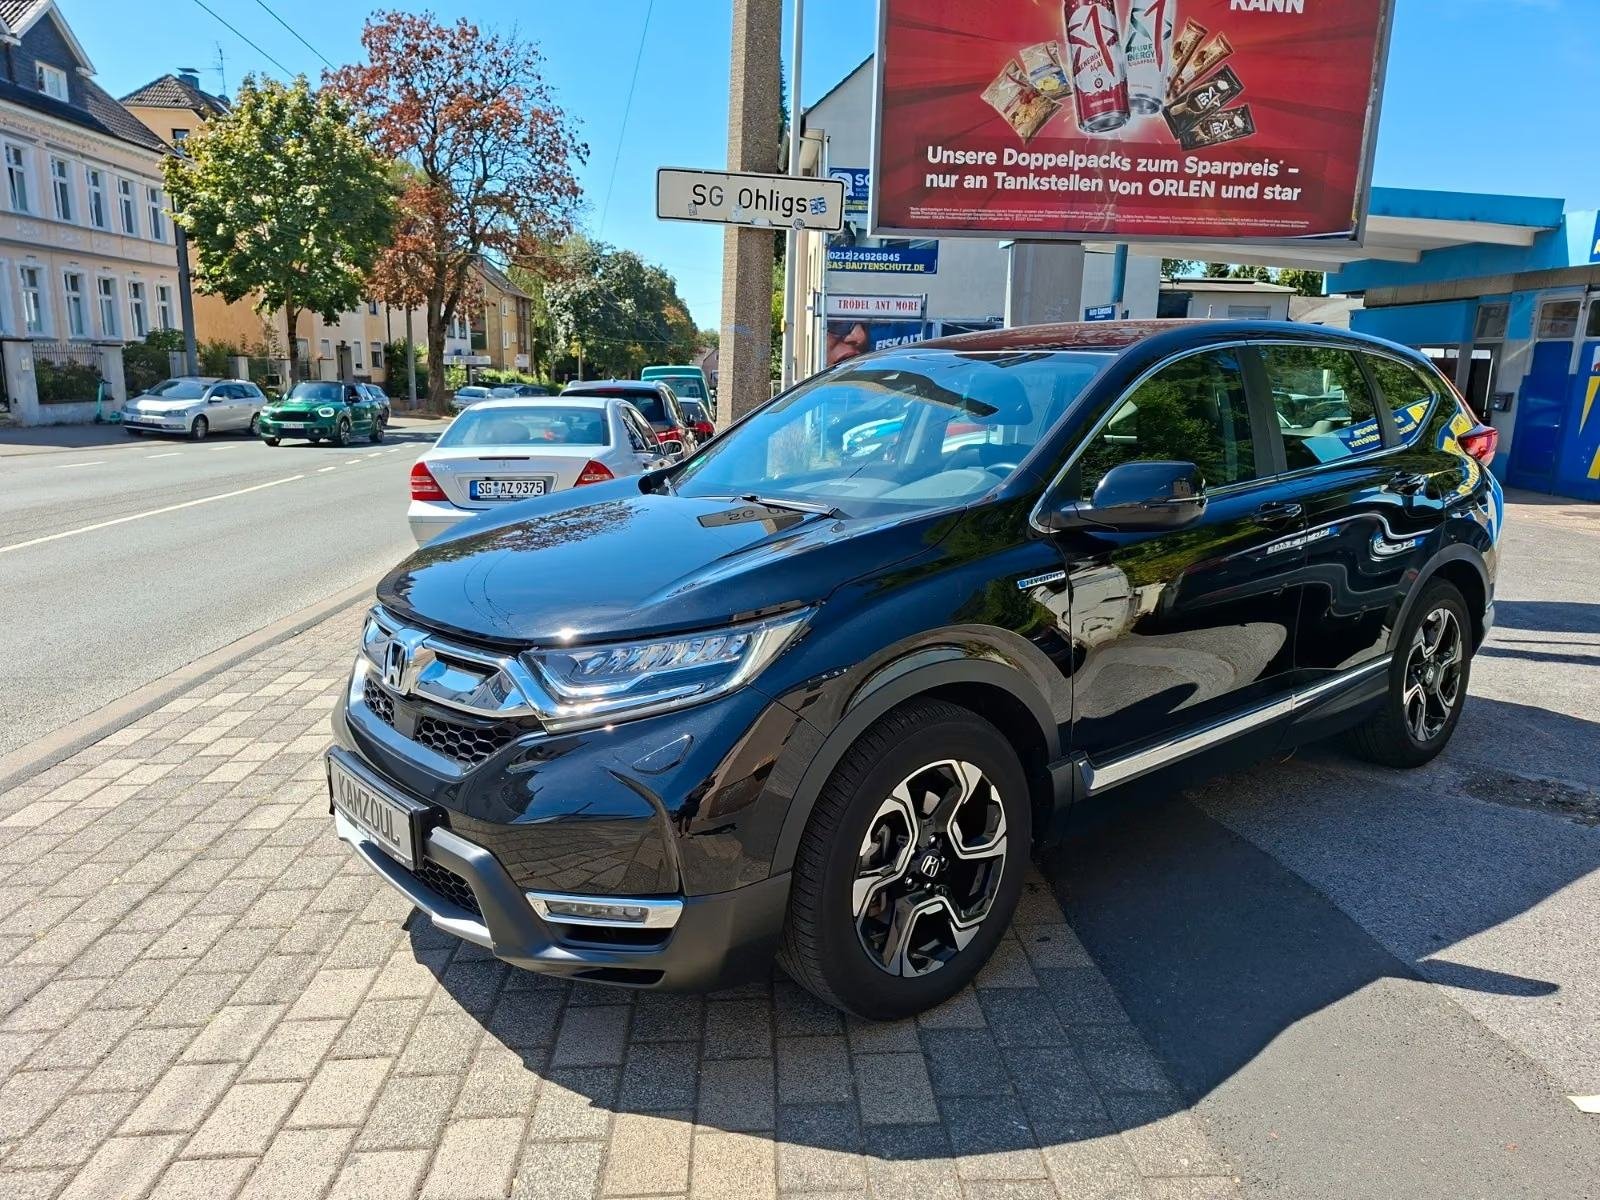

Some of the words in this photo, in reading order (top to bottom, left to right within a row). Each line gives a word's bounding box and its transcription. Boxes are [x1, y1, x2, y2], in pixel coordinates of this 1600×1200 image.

[1230, 0, 1304, 13] KANN
[927, 145, 997, 166] Unsere
[1003, 148, 1132, 172] Doppelpacks
[1136, 158, 1179, 173] zum
[692, 183, 724, 207] SG
[738, 187, 808, 218] Ohligs
[925, 173, 960, 188] nur
[963, 174, 988, 189] an
[993, 171, 1104, 192] Tankstellen
[1108, 178, 1143, 195] von
[1148, 178, 1216, 198] ORLEN
[1220, 182, 1259, 199] und
[1263, 184, 1302, 202] star
[895, 301, 919, 311] MORE
[478, 482, 492, 494] SG
[500, 482, 514, 494] AZ
[515, 482, 543, 494] 9375
[337, 772, 401, 846] KAMZOUL
